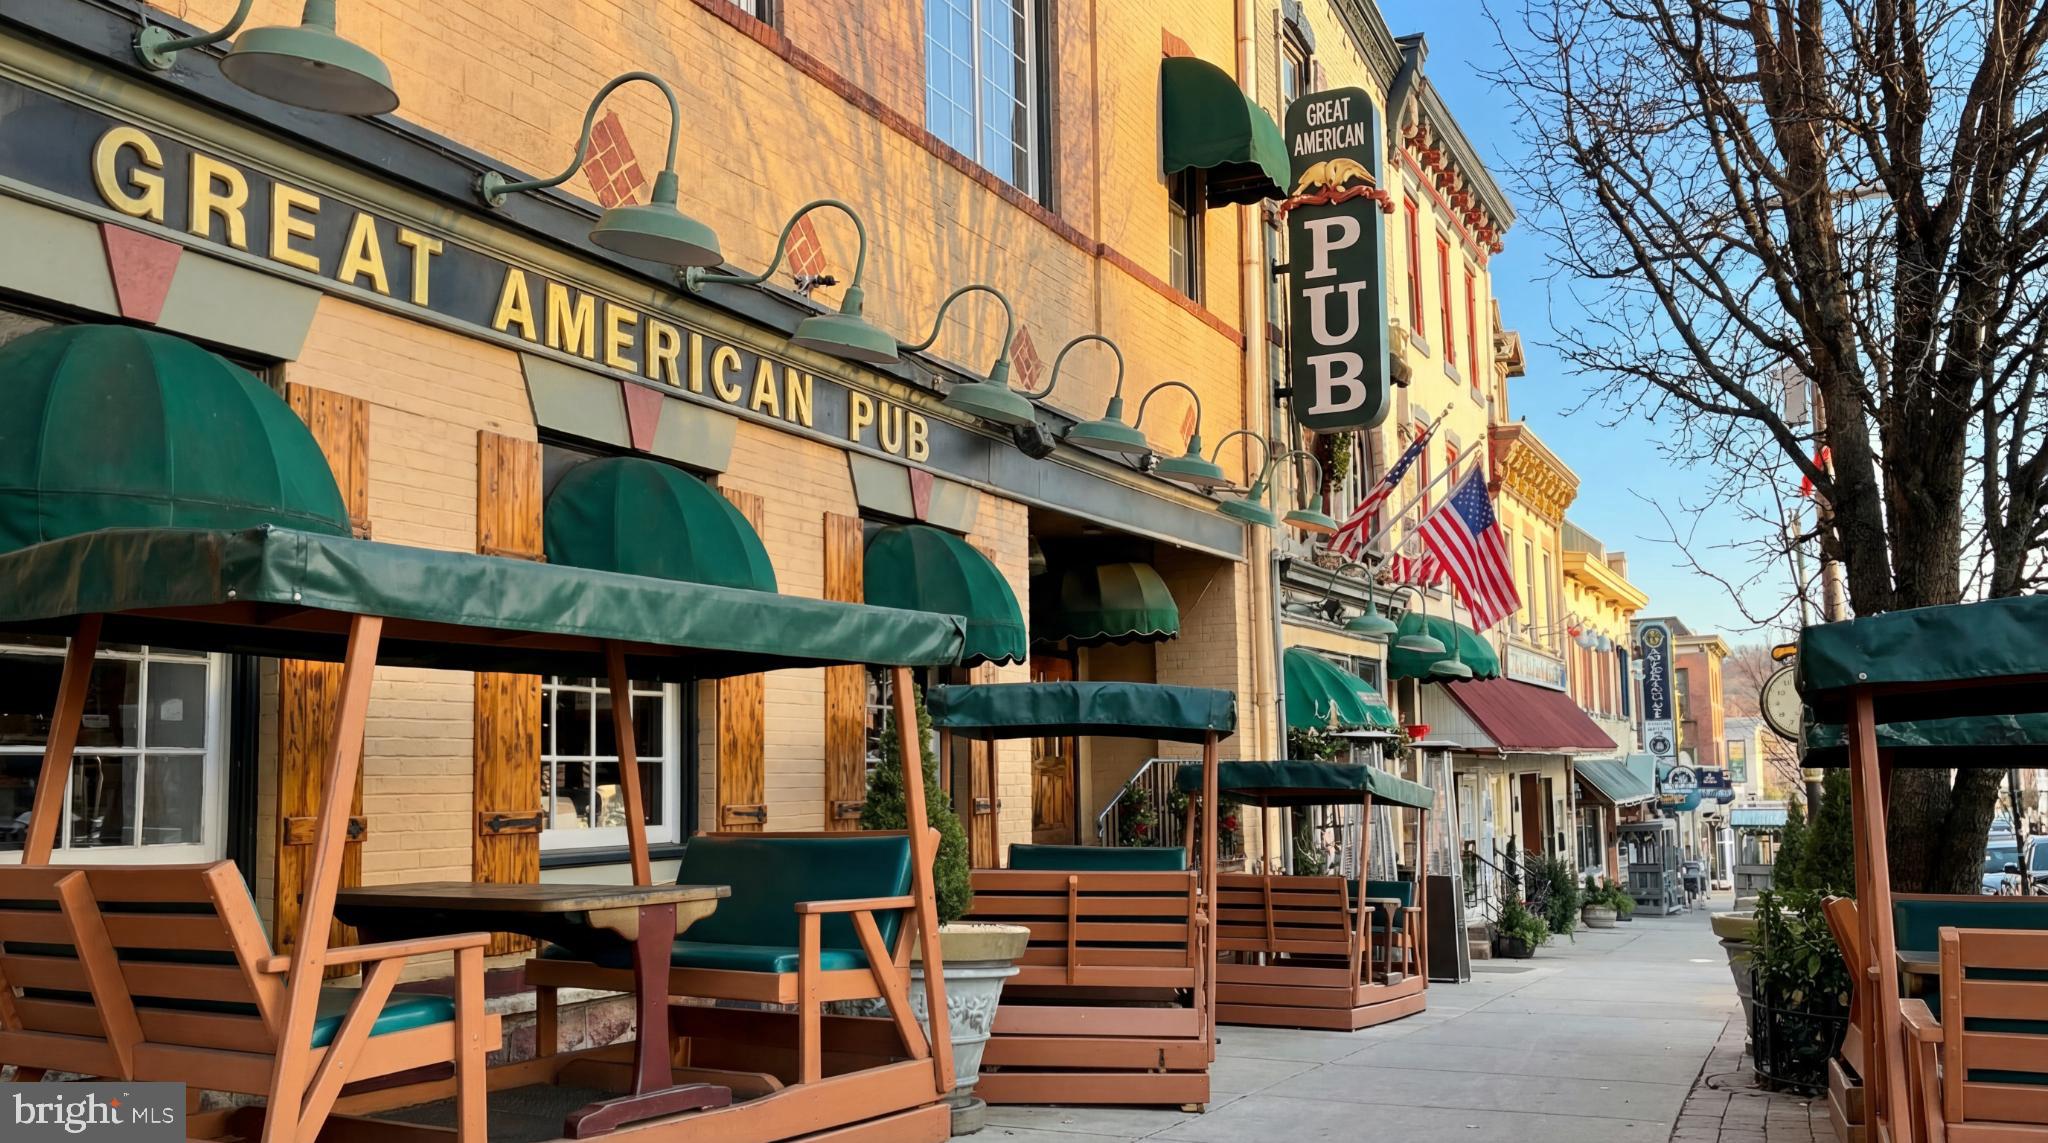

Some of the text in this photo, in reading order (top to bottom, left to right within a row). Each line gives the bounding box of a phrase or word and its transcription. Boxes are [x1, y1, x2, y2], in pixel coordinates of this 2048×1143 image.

[1294, 121, 1365, 157] AMERICAN
[1306, 97, 1351, 127] GREAT
[92, 126, 930, 463] GREAT AMERICAN PUB
[1302, 215, 1367, 416] PUB
